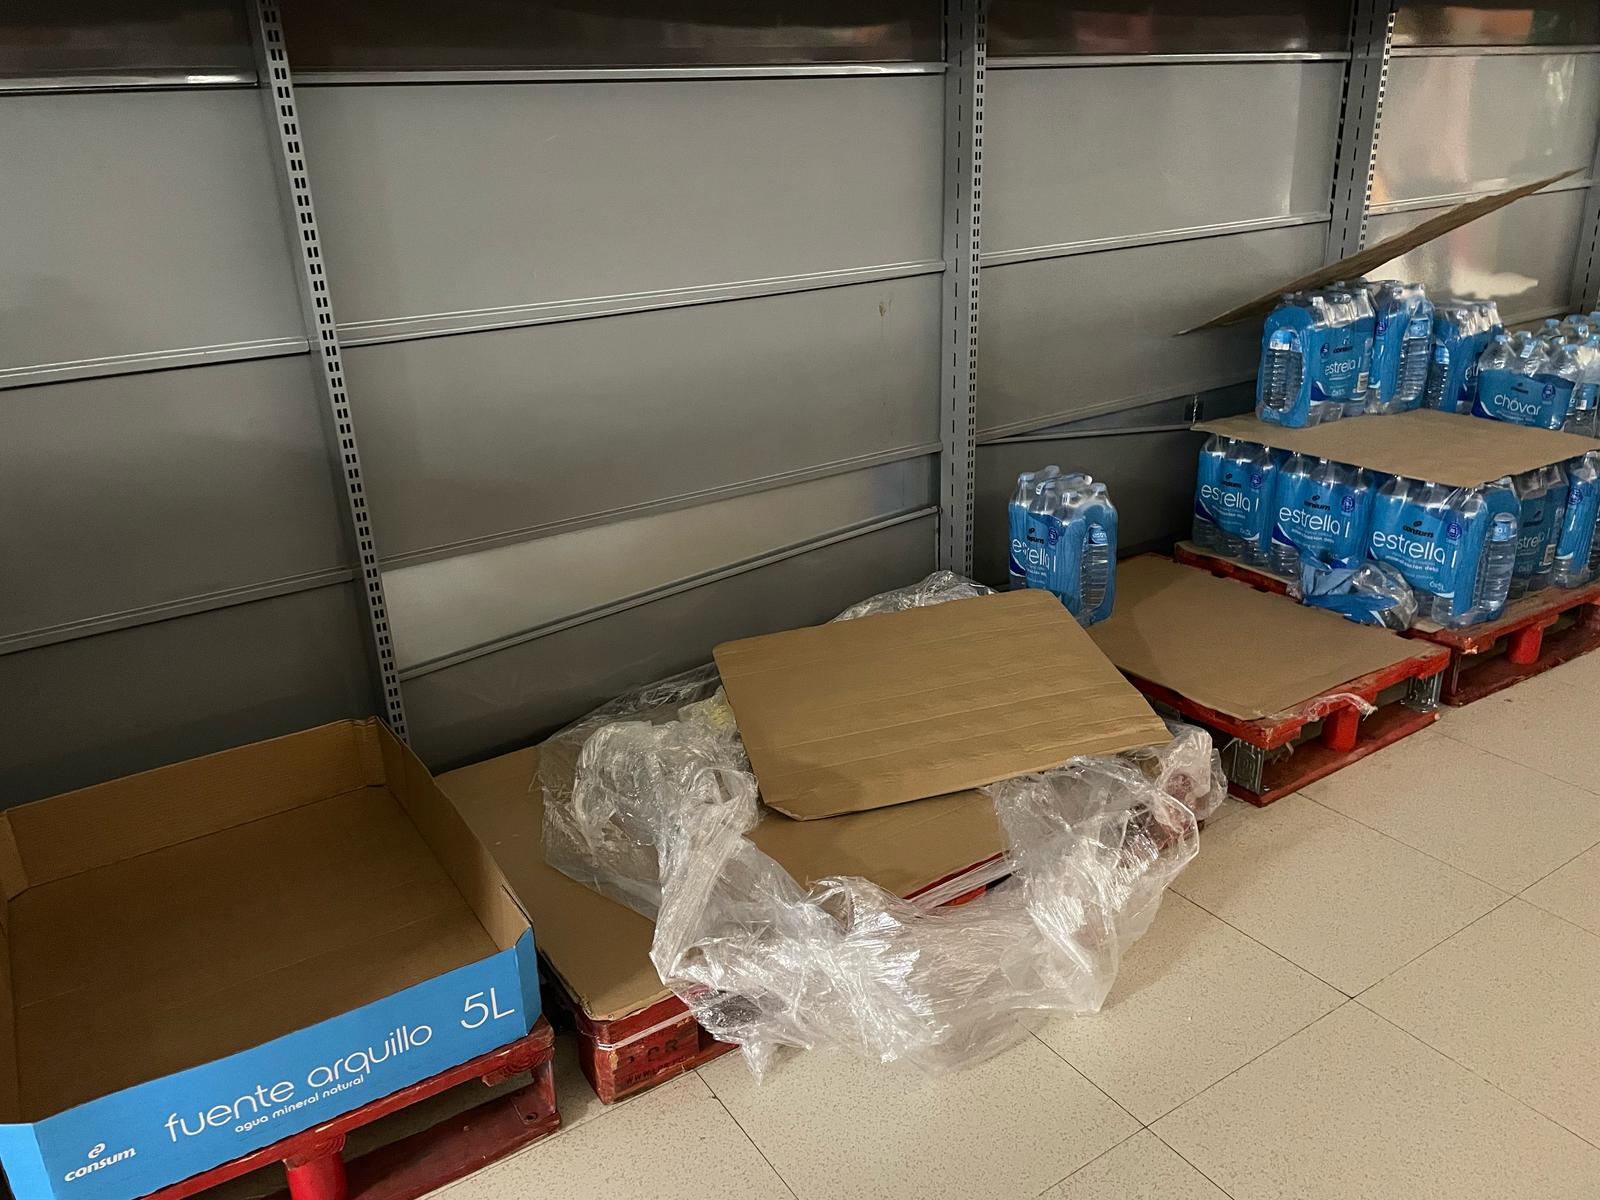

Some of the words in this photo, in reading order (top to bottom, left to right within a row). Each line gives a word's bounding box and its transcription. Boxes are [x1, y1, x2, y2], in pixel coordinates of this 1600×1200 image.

[1279, 506, 1341, 535] estrella
[1372, 530, 1446, 565] estrella
[460, 986, 516, 1030] 5L
[164, 1080, 295, 1143] fuente
[306, 1025, 433, 1088] arquillo
[234, 1114, 270, 1134] agua
[271, 1092, 320, 1120] mineral
[322, 1074, 365, 1099] natural
[63, 1146, 137, 1183] consum
